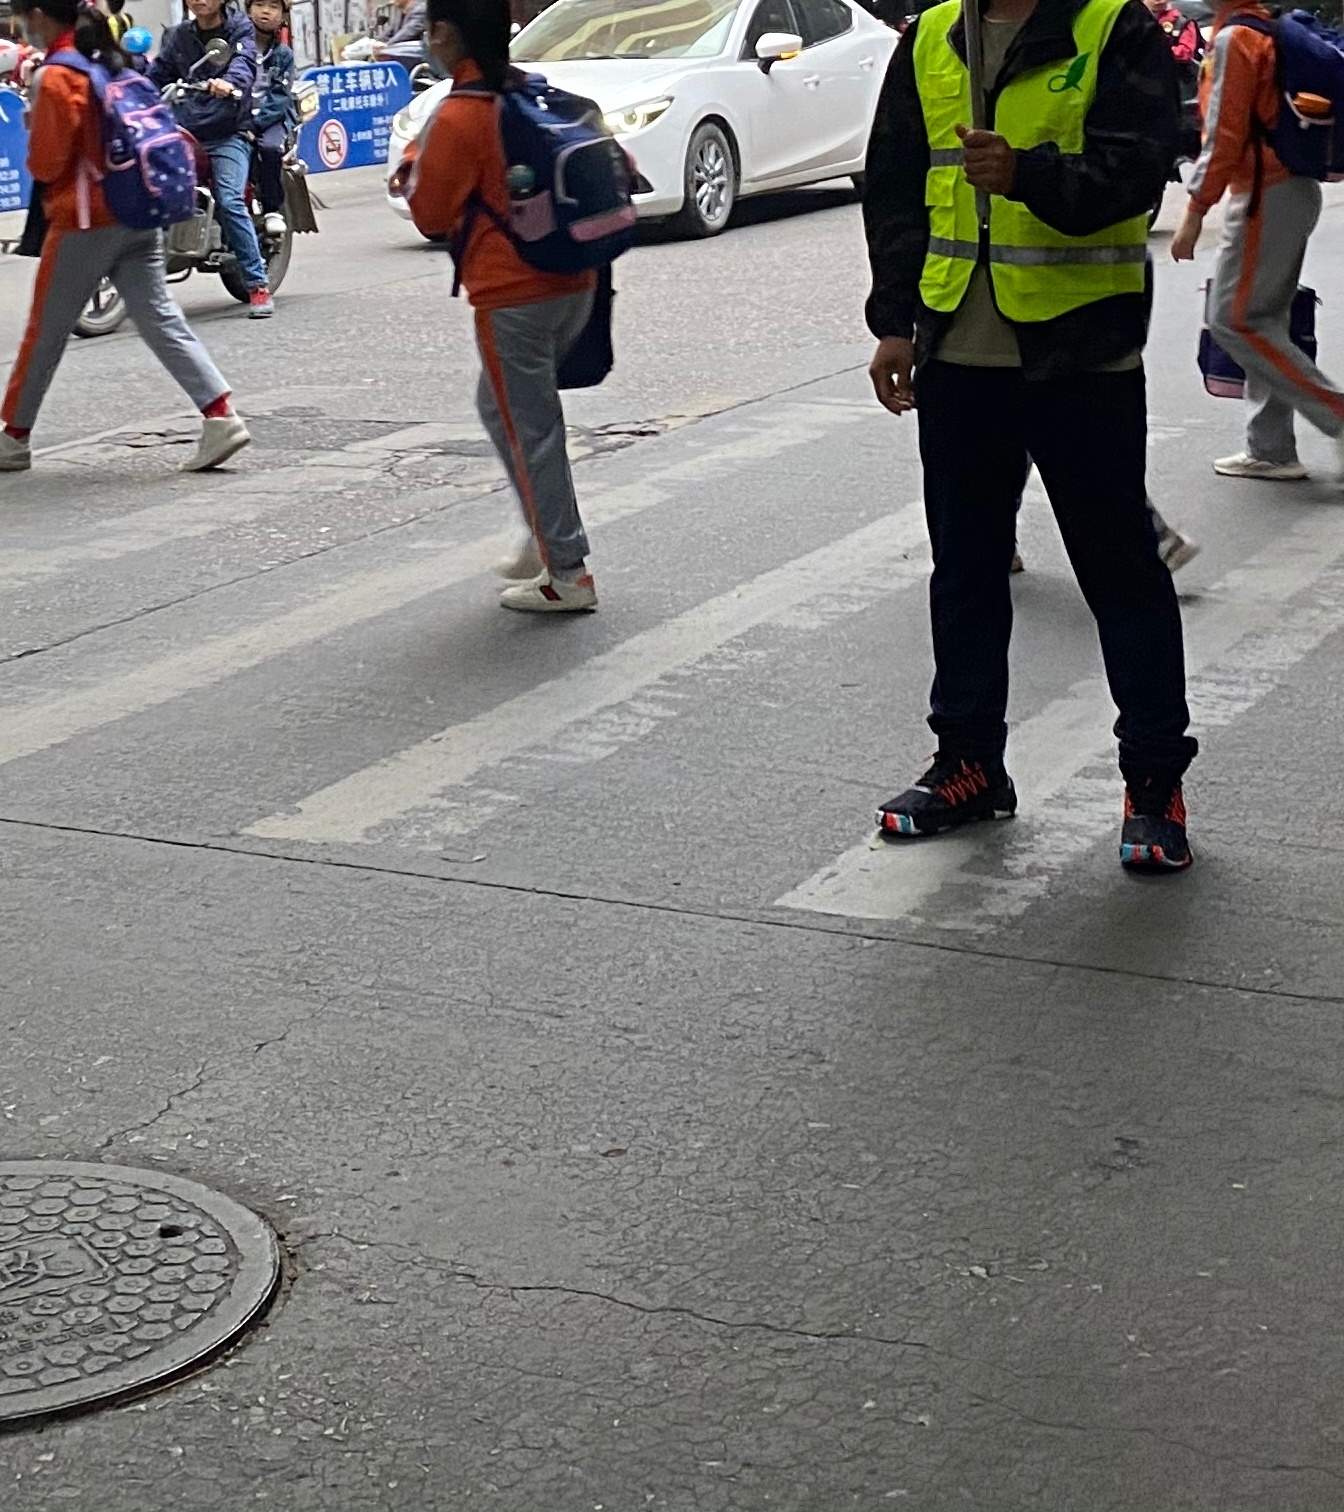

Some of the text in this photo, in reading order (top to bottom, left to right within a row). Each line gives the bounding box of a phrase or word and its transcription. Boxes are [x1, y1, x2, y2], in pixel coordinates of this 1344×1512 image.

[317, 67, 398, 96] 禁止车辆驶入
